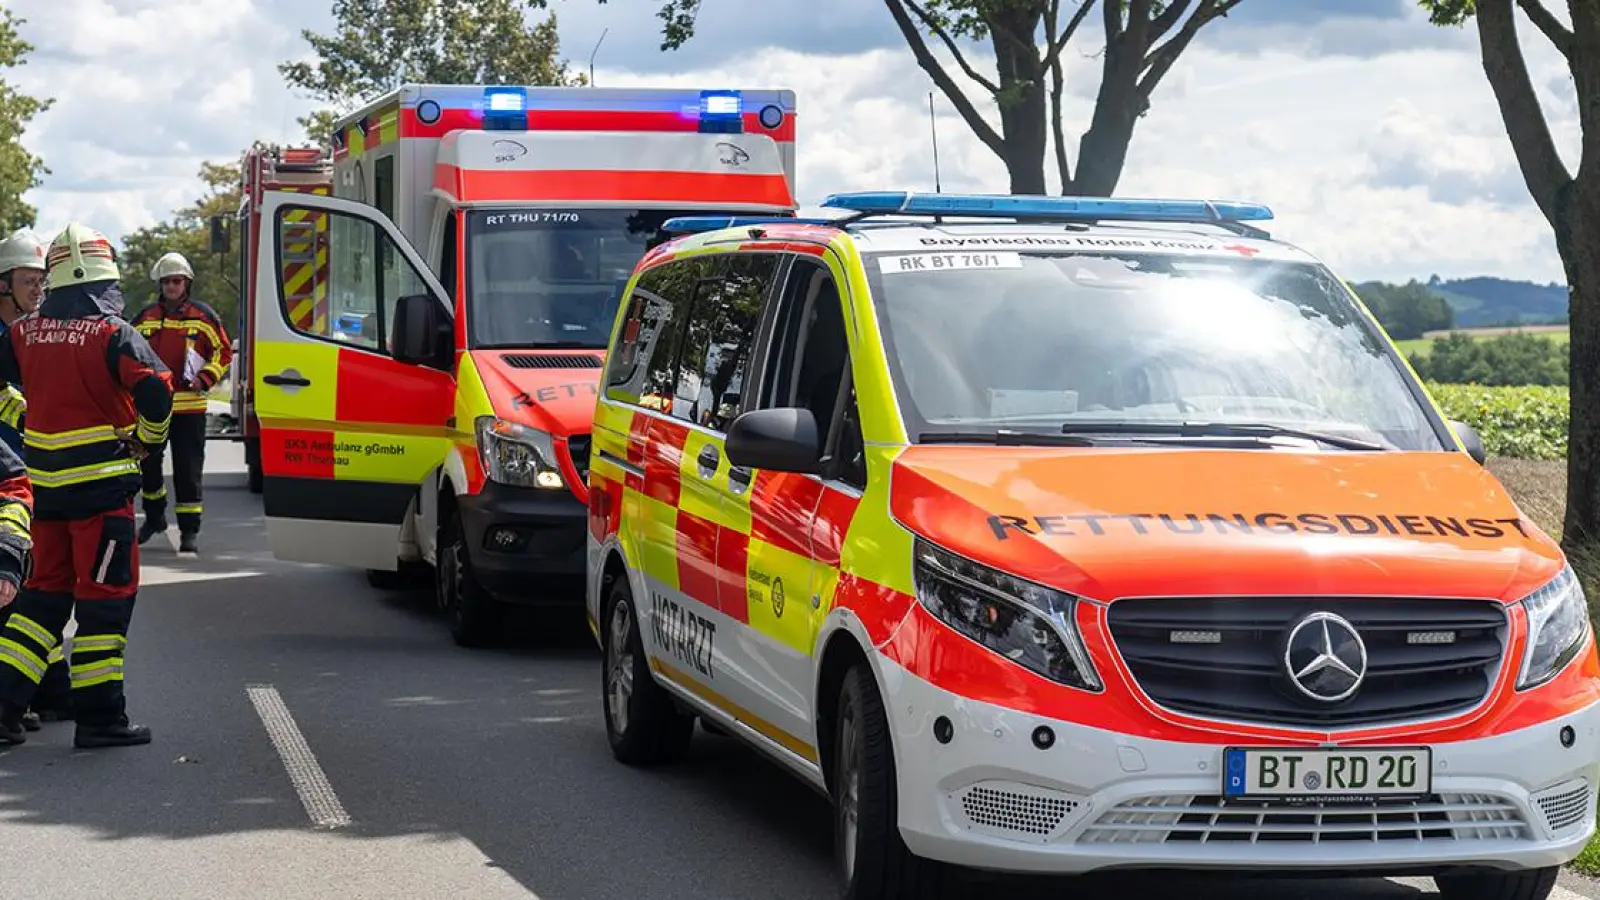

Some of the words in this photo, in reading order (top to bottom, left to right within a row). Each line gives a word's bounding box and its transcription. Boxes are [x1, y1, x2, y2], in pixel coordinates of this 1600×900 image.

[486, 215, 506, 225] RT
[509, 213, 539, 223] THU
[543, 212, 579, 222] 71/70
[920, 238, 1070, 246] Bayerisches
[1076, 238, 1145, 247] Rotes
[900, 257, 925, 270] RK
[932, 255, 955, 268] BT
[962, 255, 1000, 267] 76/1
[365, 443, 405, 456] gGmbH
[986, 513, 1532, 540] RETTUNGSDIENST
[652, 590, 716, 679] NOTARZT
[1259, 756, 1303, 788] BT
[1326, 756, 1368, 788] RD
[1377, 756, 1416, 788] 20
[1232, 776, 1240, 786] D
